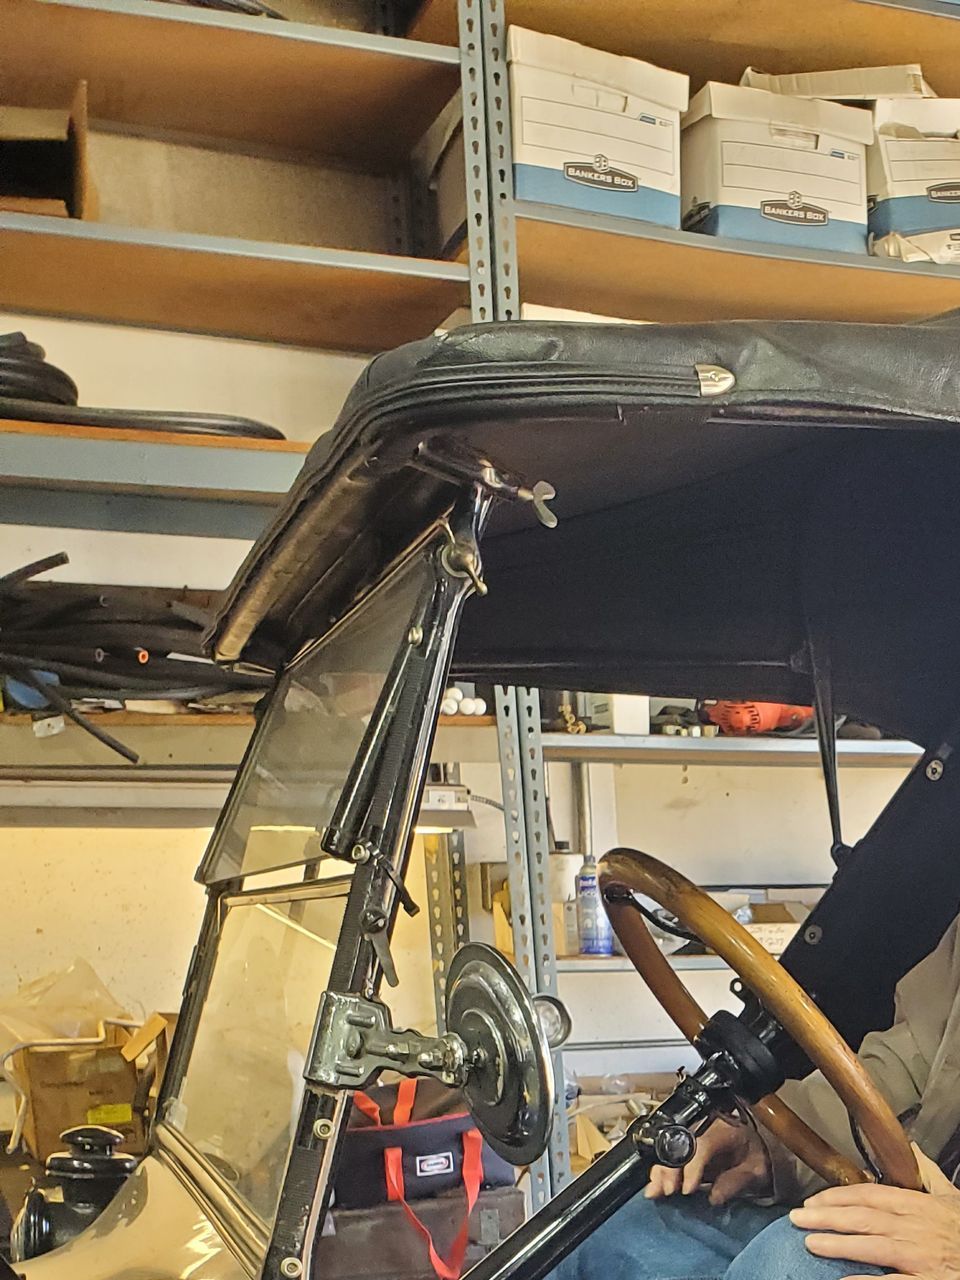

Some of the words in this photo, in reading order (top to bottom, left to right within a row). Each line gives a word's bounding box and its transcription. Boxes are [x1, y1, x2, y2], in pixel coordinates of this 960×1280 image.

[567, 167, 613, 183] BANKERS
[613, 176, 635, 188] BOX
[764, 205, 805, 218] BANKERS
[806, 211, 826, 222] BOX
